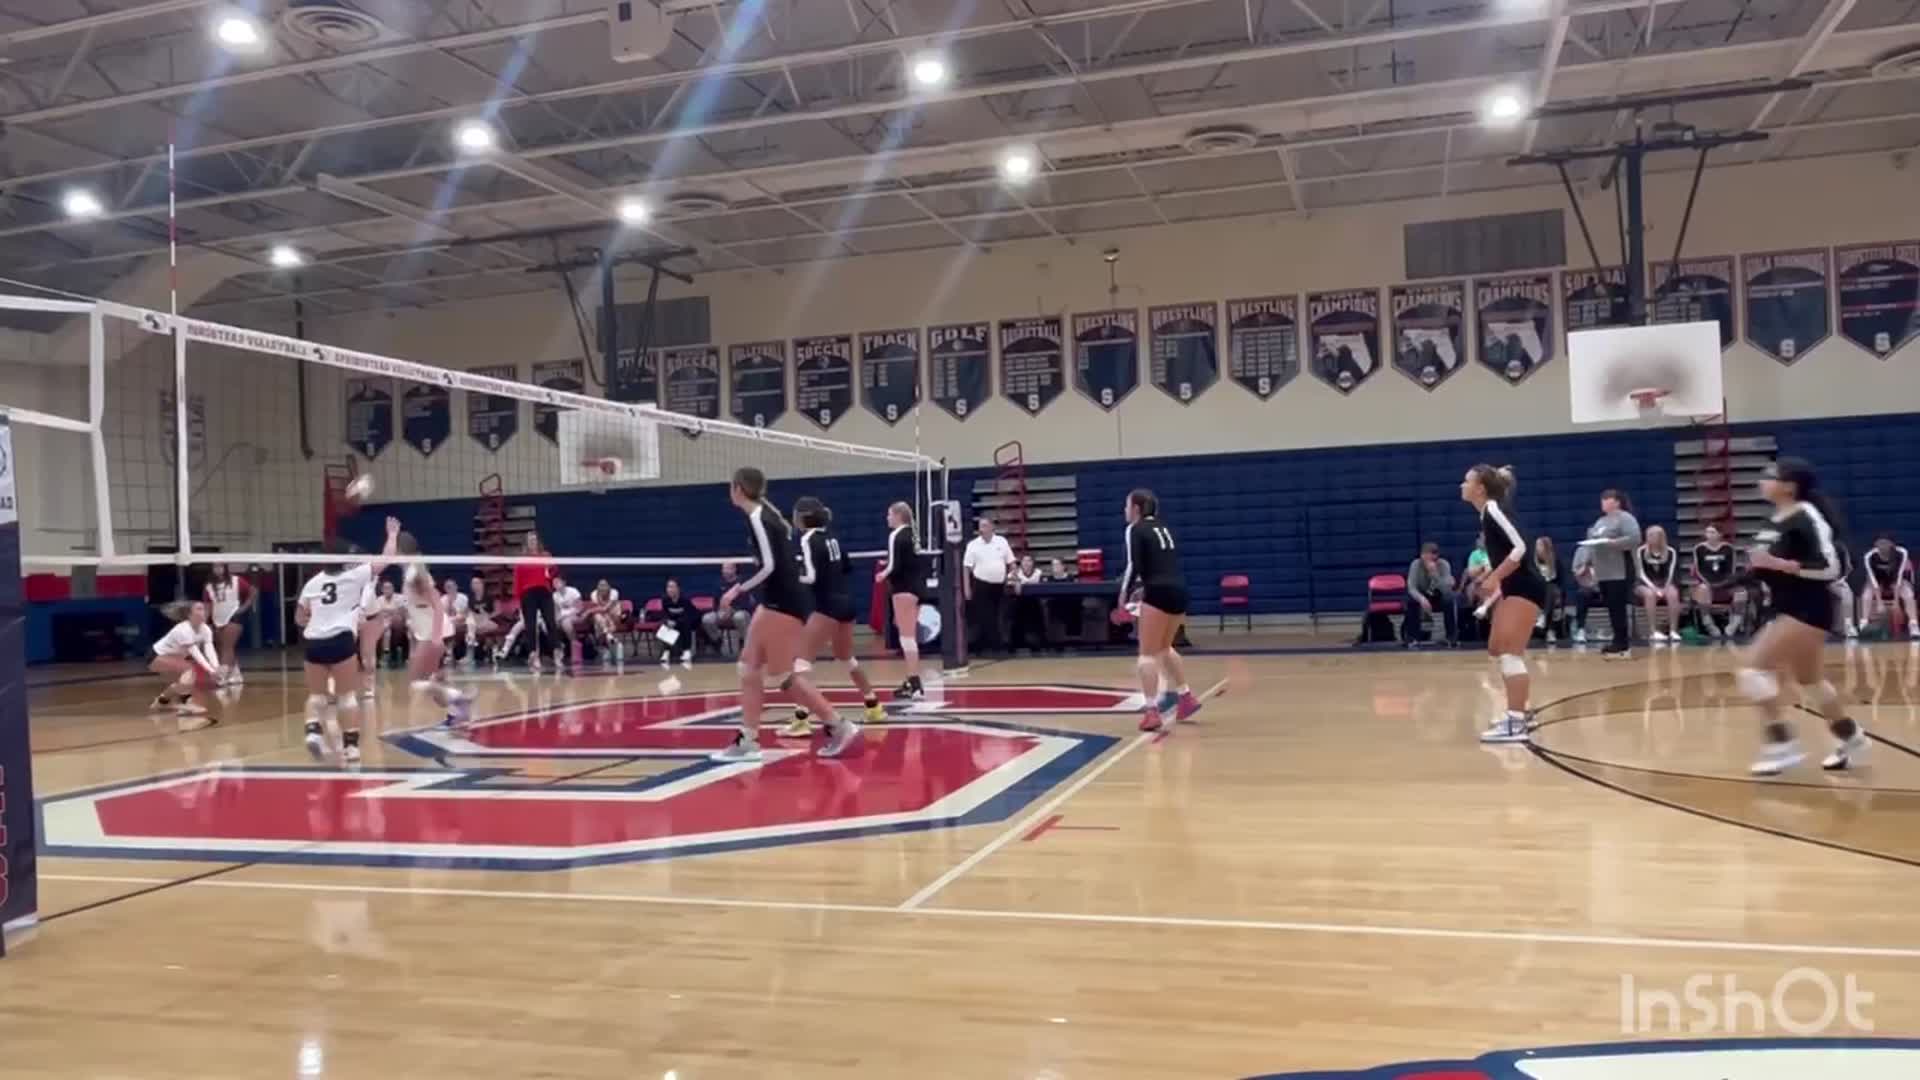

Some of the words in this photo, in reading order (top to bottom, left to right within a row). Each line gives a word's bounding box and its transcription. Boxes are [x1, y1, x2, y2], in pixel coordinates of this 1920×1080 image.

[1309, 297, 1377, 322] CHAMPIONS
[863, 332, 916, 353] TRACK
[931, 326, 986, 349] GOLF
[797, 342, 850, 366] SOCCER
[825, 539, 841, 561] 10
[321, 583, 337, 604] 3
